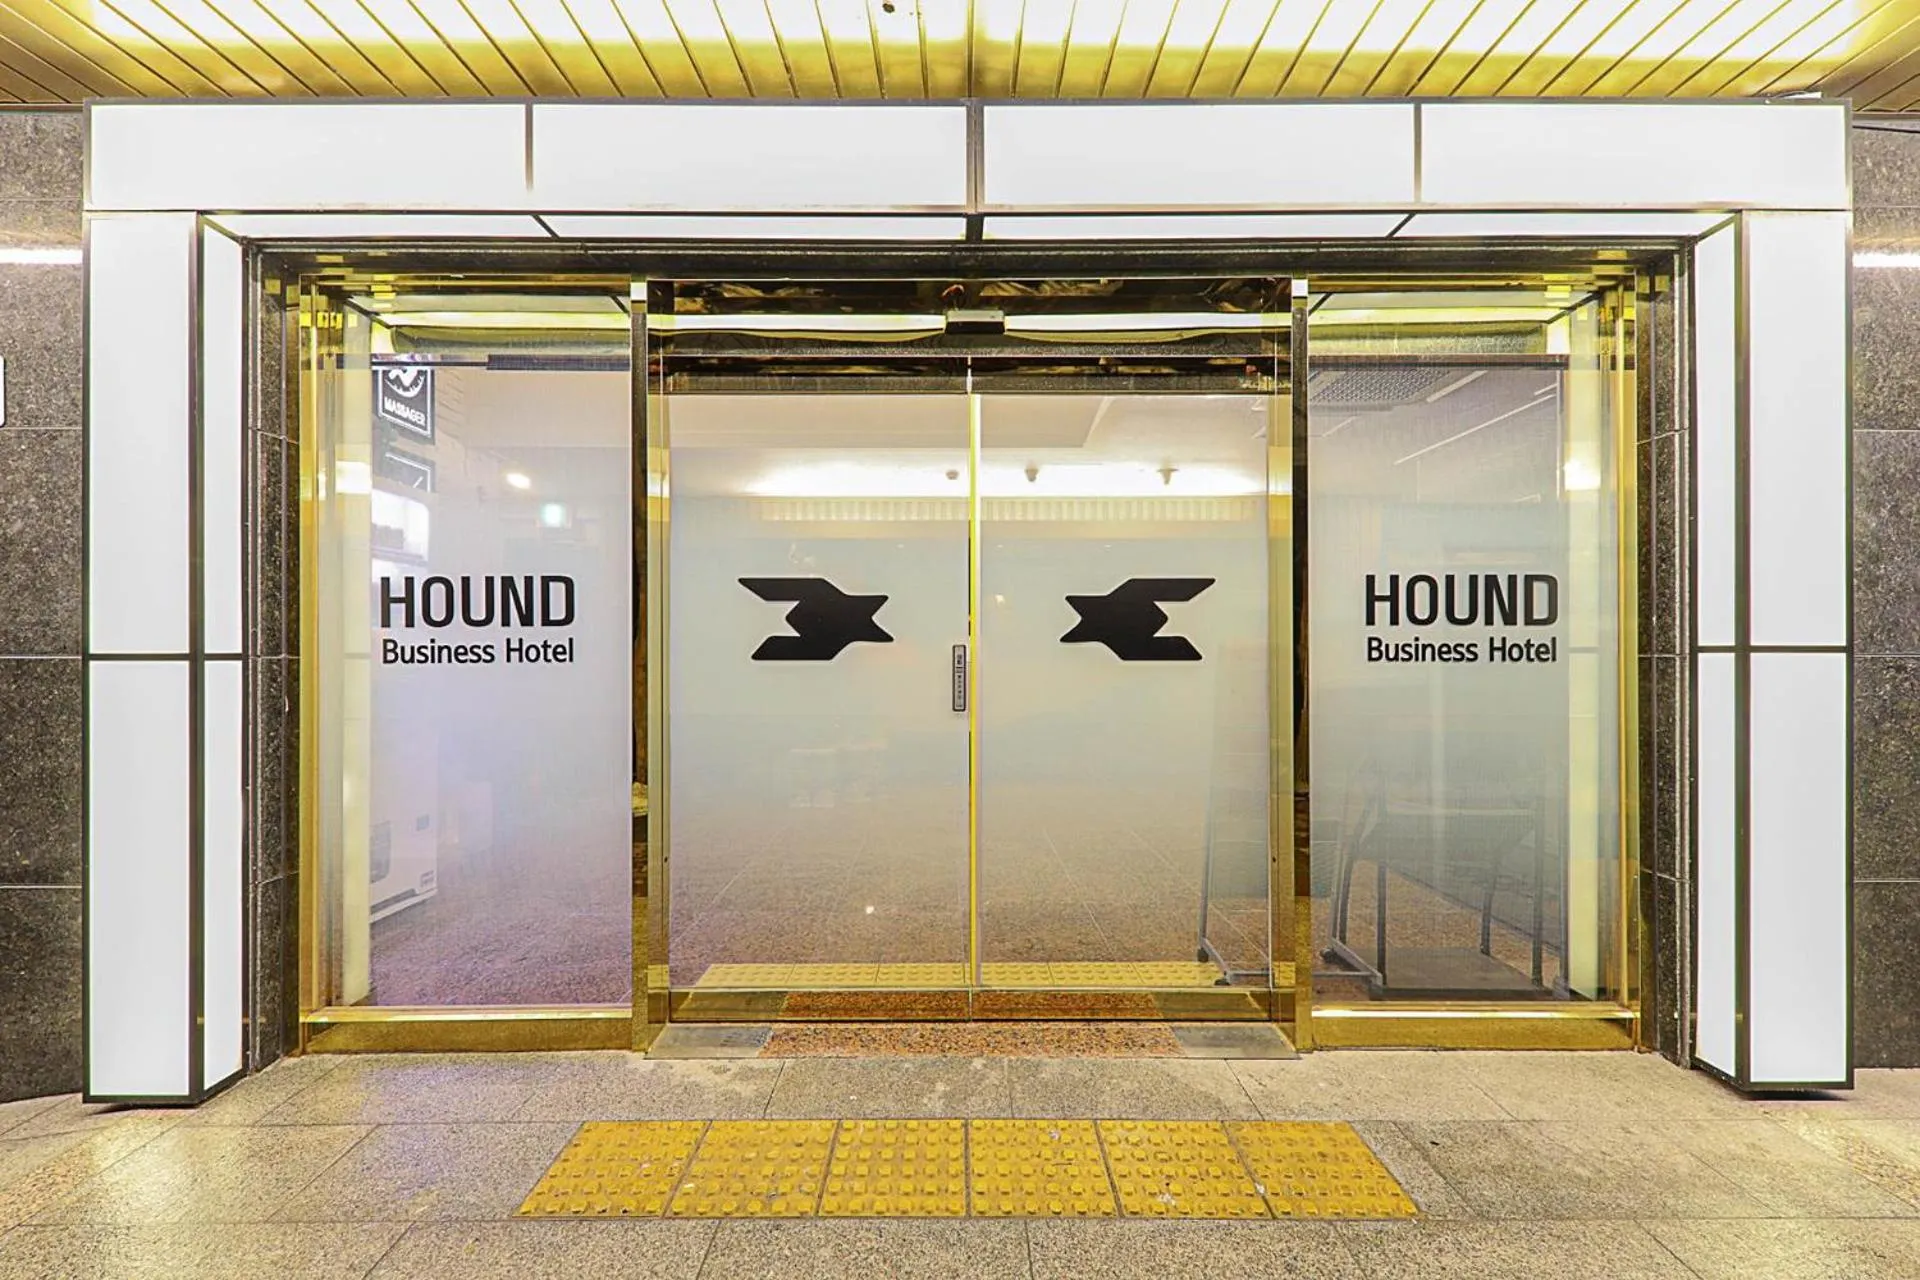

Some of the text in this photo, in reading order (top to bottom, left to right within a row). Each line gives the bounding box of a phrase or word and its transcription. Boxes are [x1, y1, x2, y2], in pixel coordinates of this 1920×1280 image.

[380, 576, 575, 628] HOUND
[1365, 574, 1558, 627] HOUND
[382, 637, 574, 665] Business Hotel
[1367, 636, 1557, 663] Business Hotel
